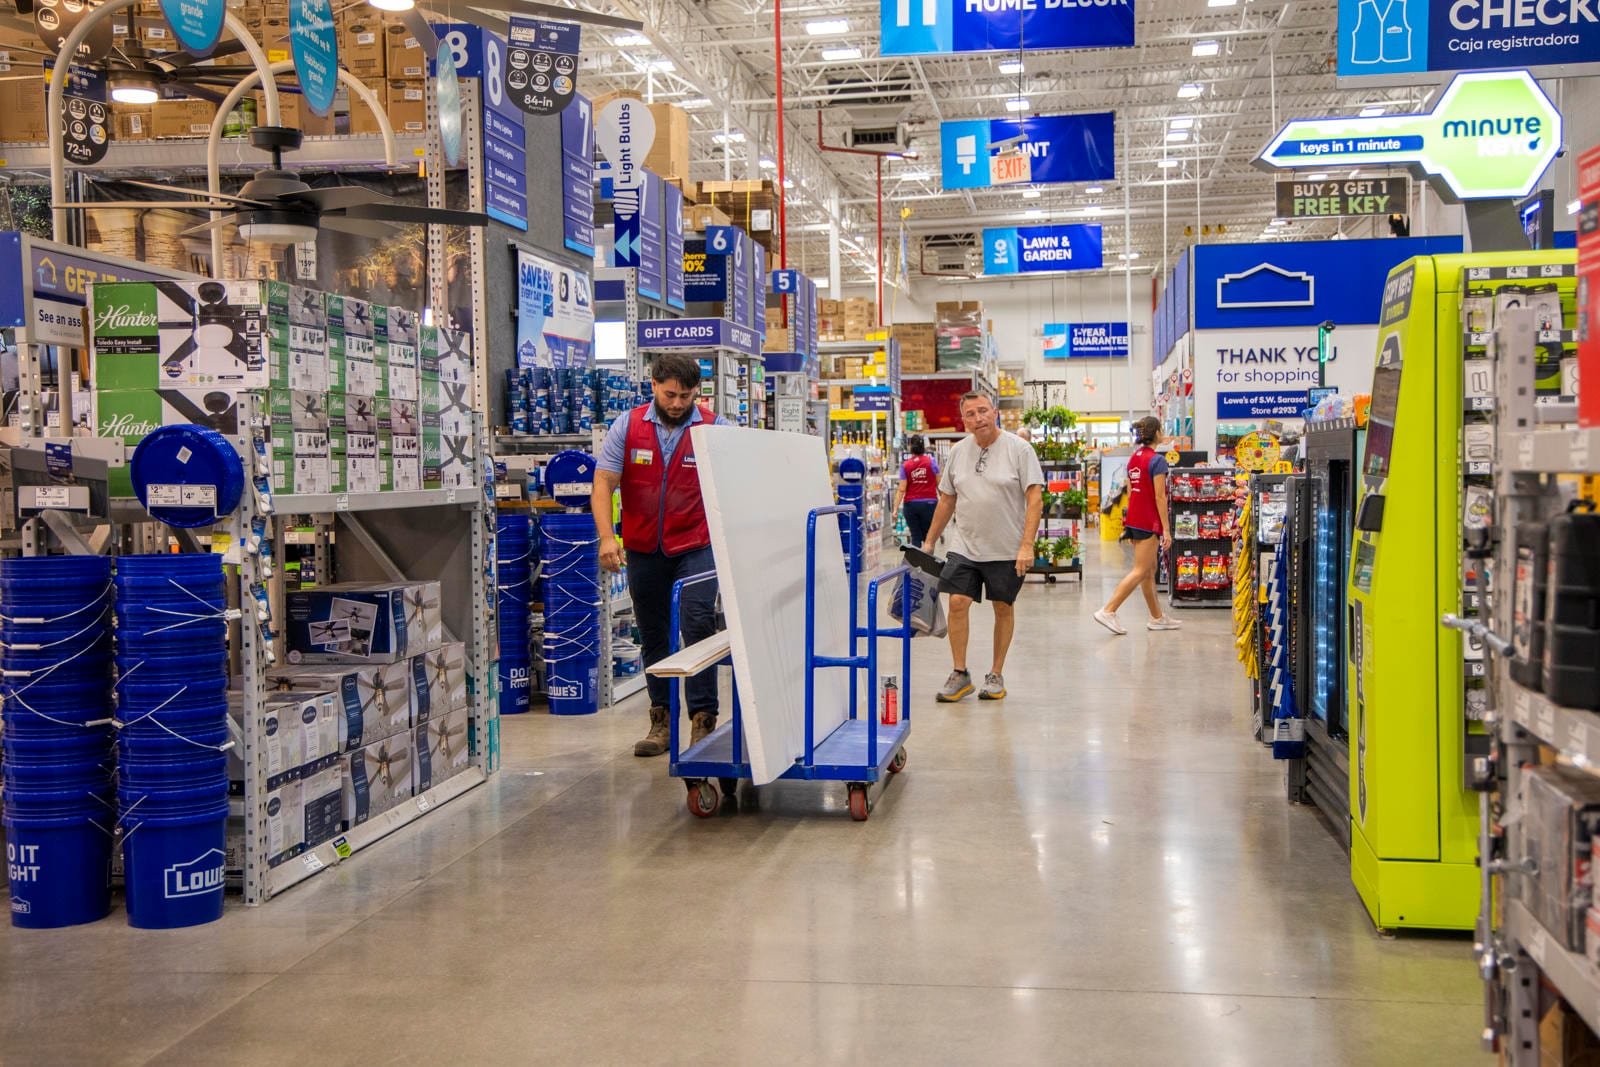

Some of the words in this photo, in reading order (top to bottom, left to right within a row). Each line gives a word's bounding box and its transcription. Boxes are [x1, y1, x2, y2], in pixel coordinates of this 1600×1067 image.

[302, 1, 324, 31] Room
[1449, 0, 1600, 31] CHECK
[445, 31, 468, 68] 8
[1448, 38, 1483, 53] Caja
[1487, 33, 1579, 51] registradora
[488, 40, 502, 106] 8
[524, 95, 553, 107] 84-in
[579, 101, 589, 157] 7
[619, 104, 631, 144] Bulbs
[1443, 117, 1541, 138] minute
[67, 143, 92, 156] 72-in
[1300, 142, 1329, 155] keys
[1332, 141, 1344, 152] in
[1347, 141, 1354, 152] 1
[1357, 139, 1401, 151] minute
[620, 147, 633, 184] Light
[997, 157, 1023, 179] EXIT
[1293, 184, 1324, 197] BUY
[1329, 183, 1340, 196] 2
[1344, 181, 1374, 195] GET
[1380, 180, 1387, 193] 1
[1294, 197, 1341, 216] FREE
[1348, 195, 1390, 214] KEY
[713, 230, 727, 250] 6
[1023, 236, 1059, 249] LAWN
[1061, 235, 1070, 247] &
[735, 232, 742, 267] 6
[1023, 248, 1072, 262] GARDEN
[521, 263, 541, 289] SAVE
[543, 270, 554, 293] 5%
[778, 273, 790, 290] 5
[521, 287, 533, 299] EVERY
[533, 290, 542, 301] DAY
[39, 309, 53, 323] See
[56, 316, 66, 326] an
[68, 317, 82, 328] ass
[95, 305, 157, 330] Hunter
[645, 328, 671, 338] GIFT
[674, 326, 714, 338] CARDS
[1072, 336, 1128, 346] GUARANTEE
[1073, 328, 1106, 337] 1-YEAR
[1216, 348, 1287, 364] THANK
[1216, 369, 1240, 383] for
[1244, 367, 1320, 385] shopping
[1223, 396, 1249, 405] Lowe's
[1250, 396, 1258, 404] of
[1258, 396, 1276, 404] S.W.
[1277, 396, 1308, 404] Sarasot
[1251, 407, 1271, 415] Store
[1272, 406, 1297, 414] #2933
[510, 668, 525, 678] DO
[549, 685, 577, 696] OWE'S
[20, 845, 39, 863] IT
